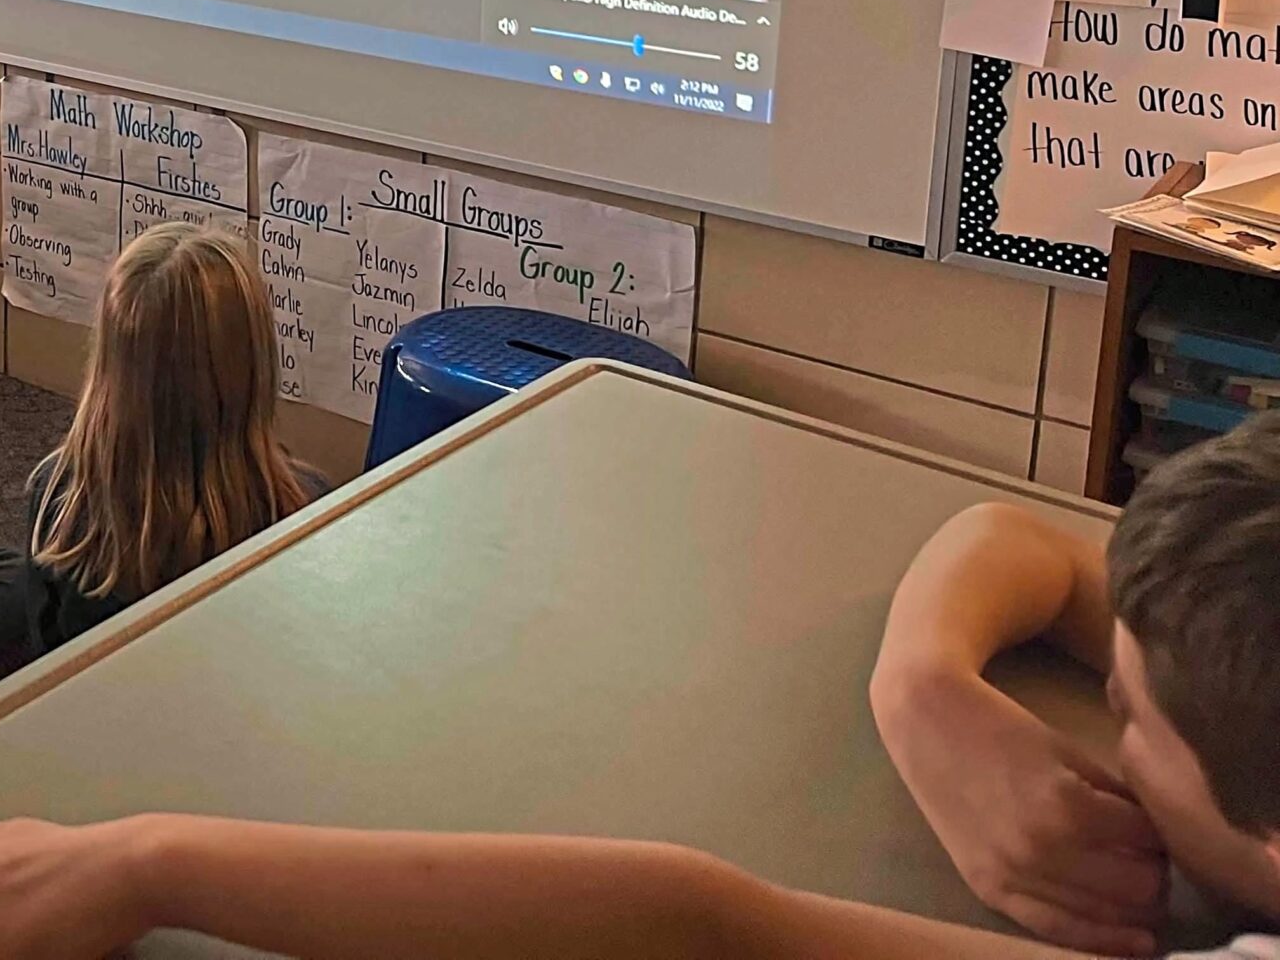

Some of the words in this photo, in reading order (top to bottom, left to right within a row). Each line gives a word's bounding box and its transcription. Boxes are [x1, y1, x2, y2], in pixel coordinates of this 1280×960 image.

[680, 4, 718, 22] Audio
[1145, 8, 1185, 52] do
[1208, 25, 1280, 65] ma
[733, 51, 760, 72] 58
[679, 78, 700, 93] 2:12
[701, 81, 720, 96] PM
[1027, 70, 1118, 106] make
[1138, 85, 1225, 120] areas
[1243, 98, 1277, 132] on
[49, 88, 97, 130] Math
[113, 102, 204, 160] Workshop
[1022, 122, 1104, 170] that
[7, 162, 53, 200] Working
[60, 180, 85, 201] with
[156, 155, 222, 201] Firsties
[11, 196, 39, 224] group
[270, 181, 328, 233] Group
[371, 169, 446, 223] Small
[462, 186, 544, 247] Groups
[8, 225, 72, 267] Observing
[261, 219, 302, 260] Grady
[8, 253, 57, 298] Testing
[261, 248, 305, 283] Calvin
[356, 239, 419, 284] Yelanys
[519, 245, 595, 305] Group
[608, 261, 636, 296] 2:
[352, 273, 416, 313] Jazmin
[451, 267, 507, 301] Zelda
[352, 303, 403, 336] Lincol
[588, 296, 651, 337] Elijah
